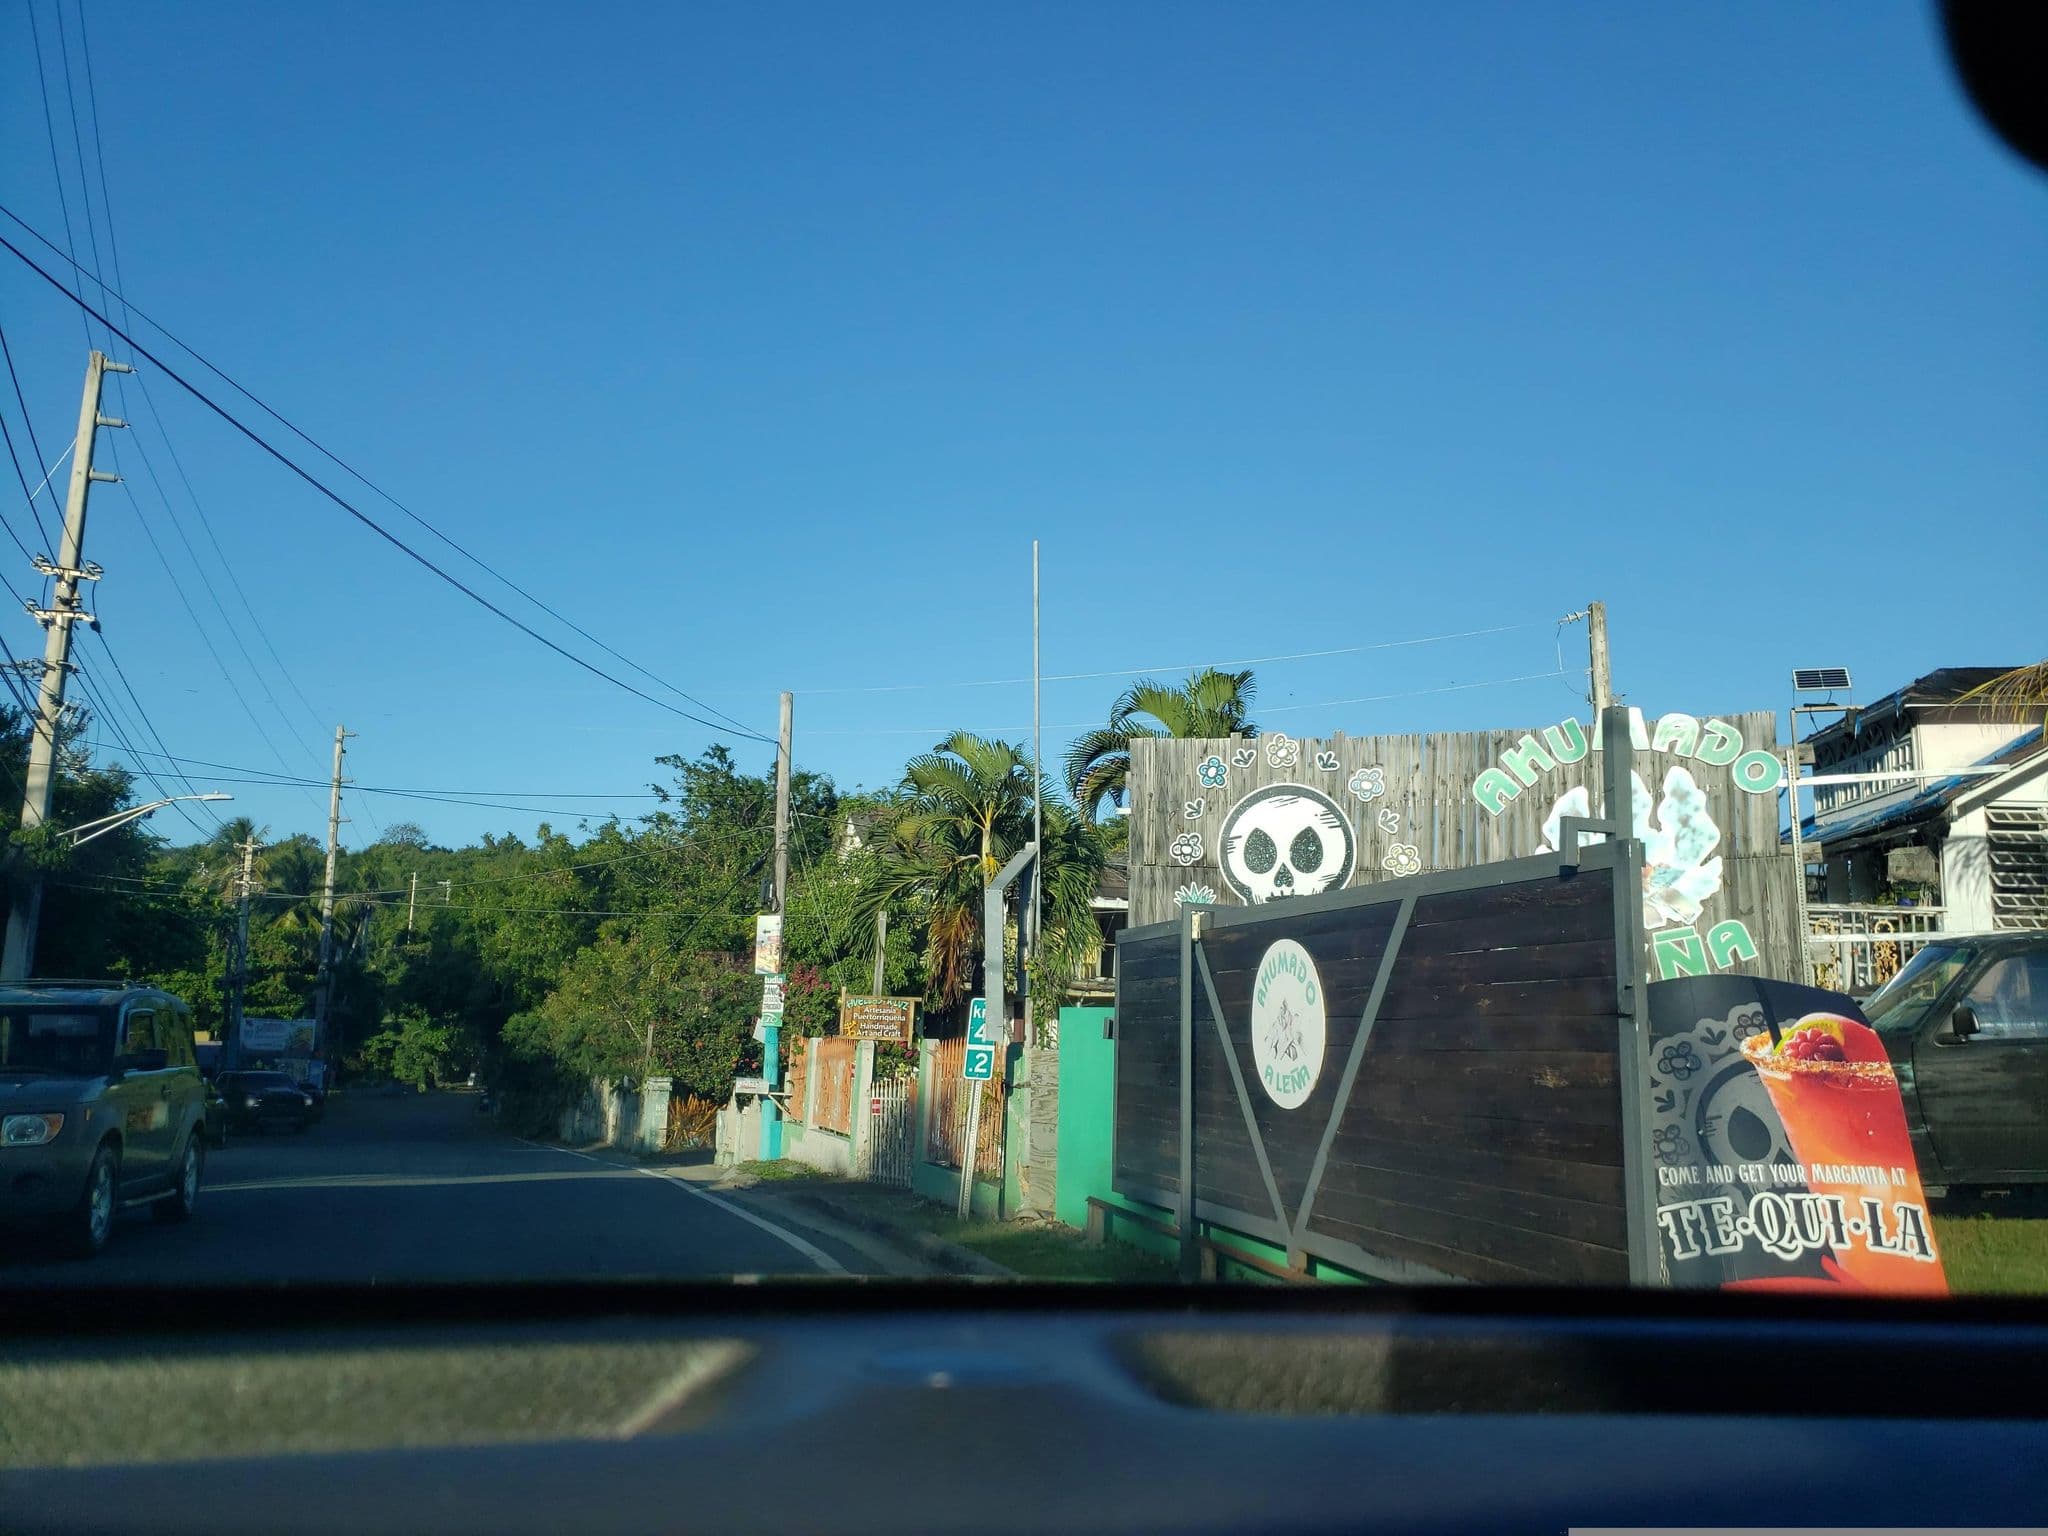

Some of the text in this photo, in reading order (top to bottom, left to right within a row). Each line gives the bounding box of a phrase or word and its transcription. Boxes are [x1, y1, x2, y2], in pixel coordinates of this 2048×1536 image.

[1258, 952, 1316, 1007] AHUMADO
[860, 1022, 897, 1030] Handmade
[884, 1030, 901, 1038] Craft
[968, 1053, 988, 1073] .2
[1264, 1064, 1311, 1094] A LEÑA
[1658, 1163, 1906, 1186] COME AND GET YOUR MARGARITA AT
